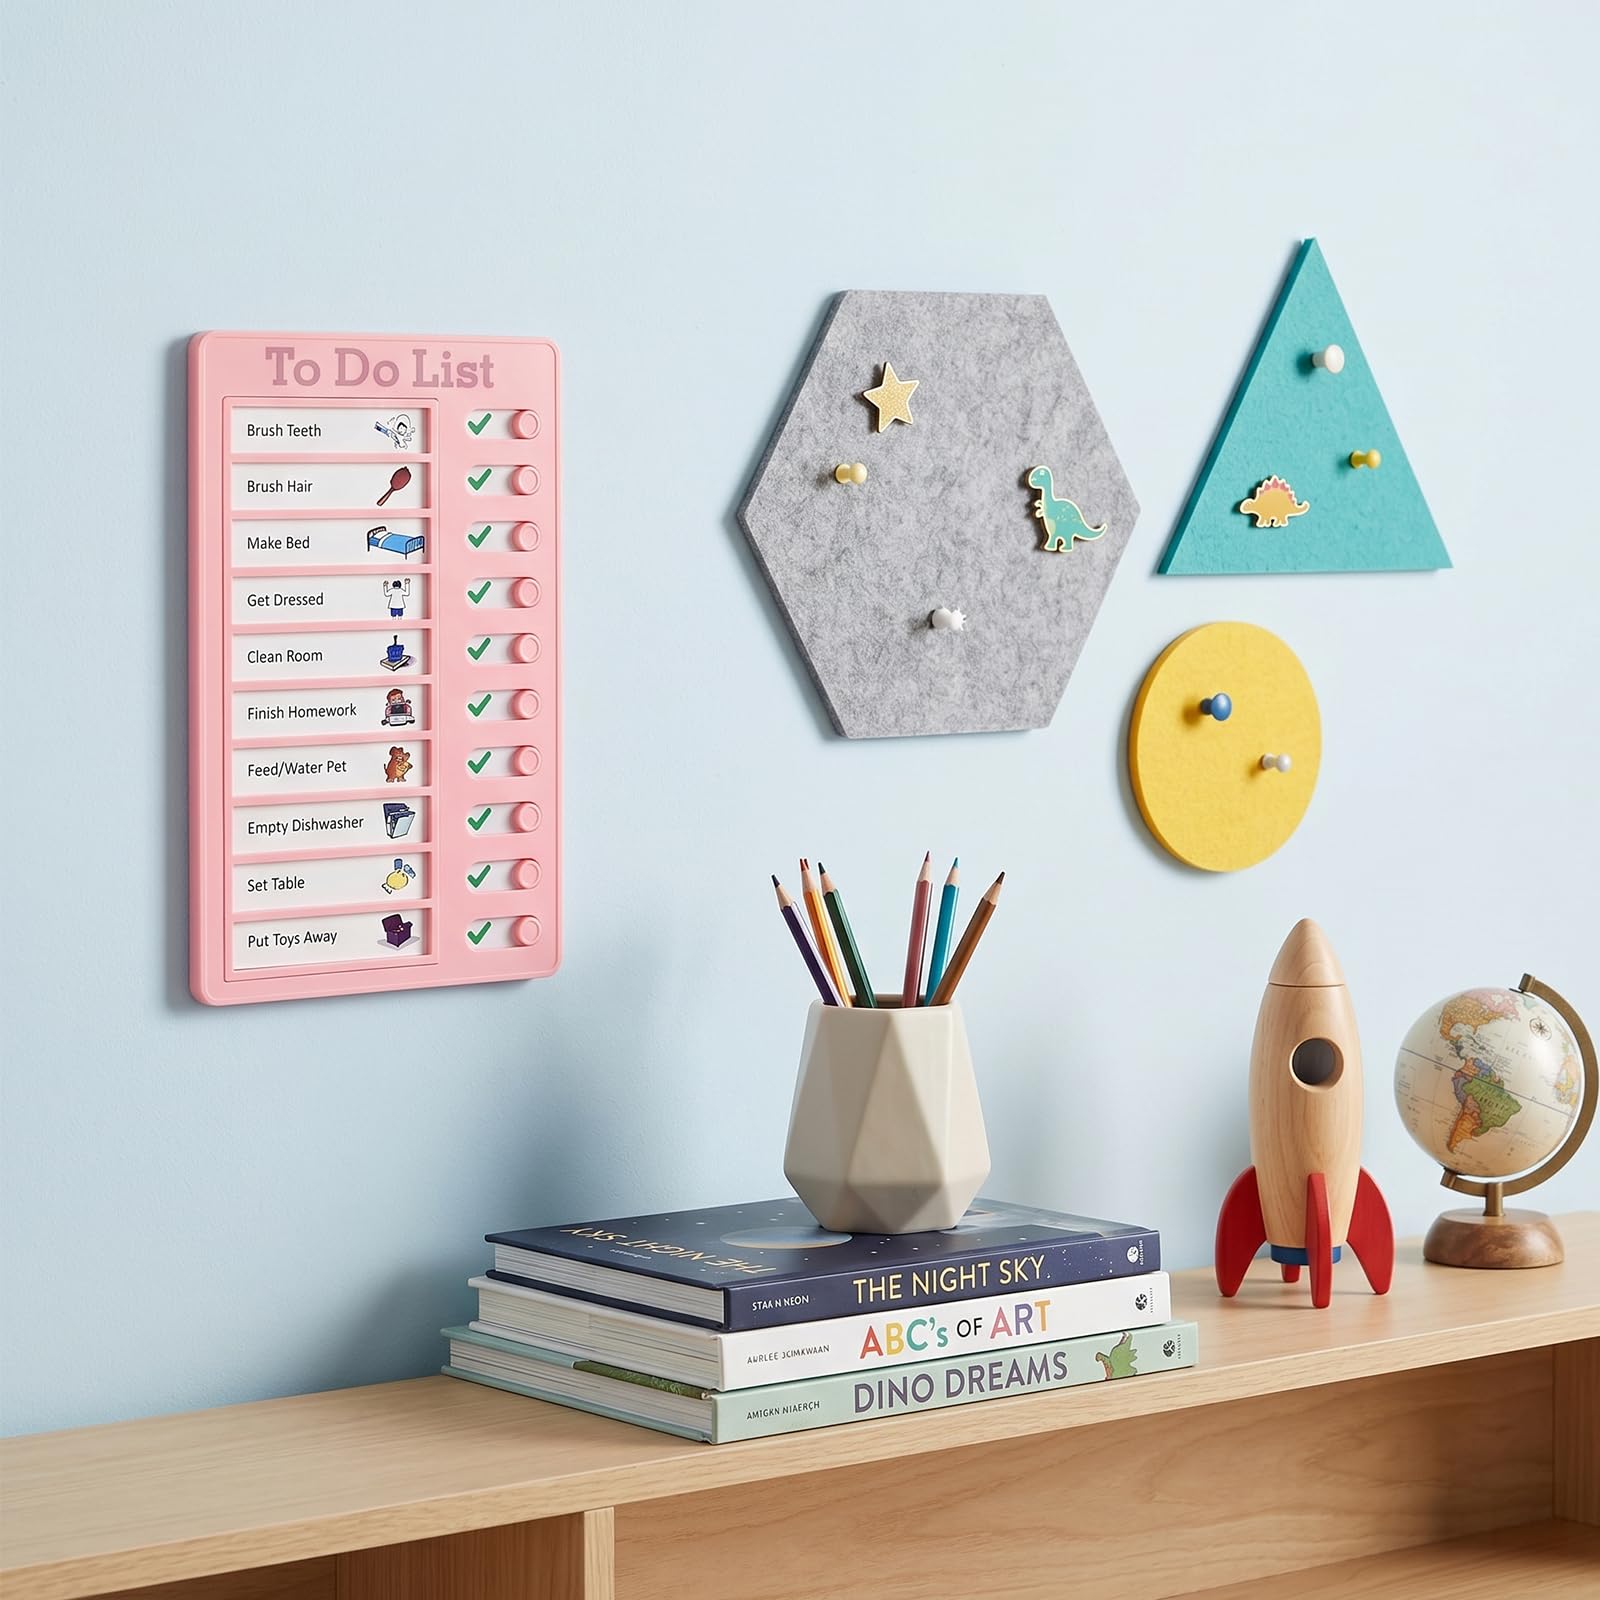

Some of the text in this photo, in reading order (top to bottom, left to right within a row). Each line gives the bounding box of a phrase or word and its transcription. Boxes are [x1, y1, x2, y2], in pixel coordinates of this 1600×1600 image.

[265, 347, 494, 389] To Do List
[248, 424, 321, 436] Brush Teeth
[248, 480, 312, 492] Brush Hair
[248, 536, 309, 549] Make Bed
[248, 593, 323, 606] Get Dressed
[248, 650, 322, 663] Clean Room
[248, 703, 356, 720] Finish Homework
[249, 760, 346, 777] Feed/Water Pet
[249, 816, 364, 836] Empty Dishwasher
[248, 876, 304, 892] Set Table
[249, 931, 337, 948] Put Toys Away
[560, 1228, 627, 1241] SKY
[616, 1239, 716, 1261] NIGHT
[704, 1258, 776, 1273] THE
[853, 1254, 1045, 1303] THE NIGHT SKY
[860, 1300, 1050, 1359] ABC's OF ART
[854, 1351, 1068, 1413] DINO DREAMS
